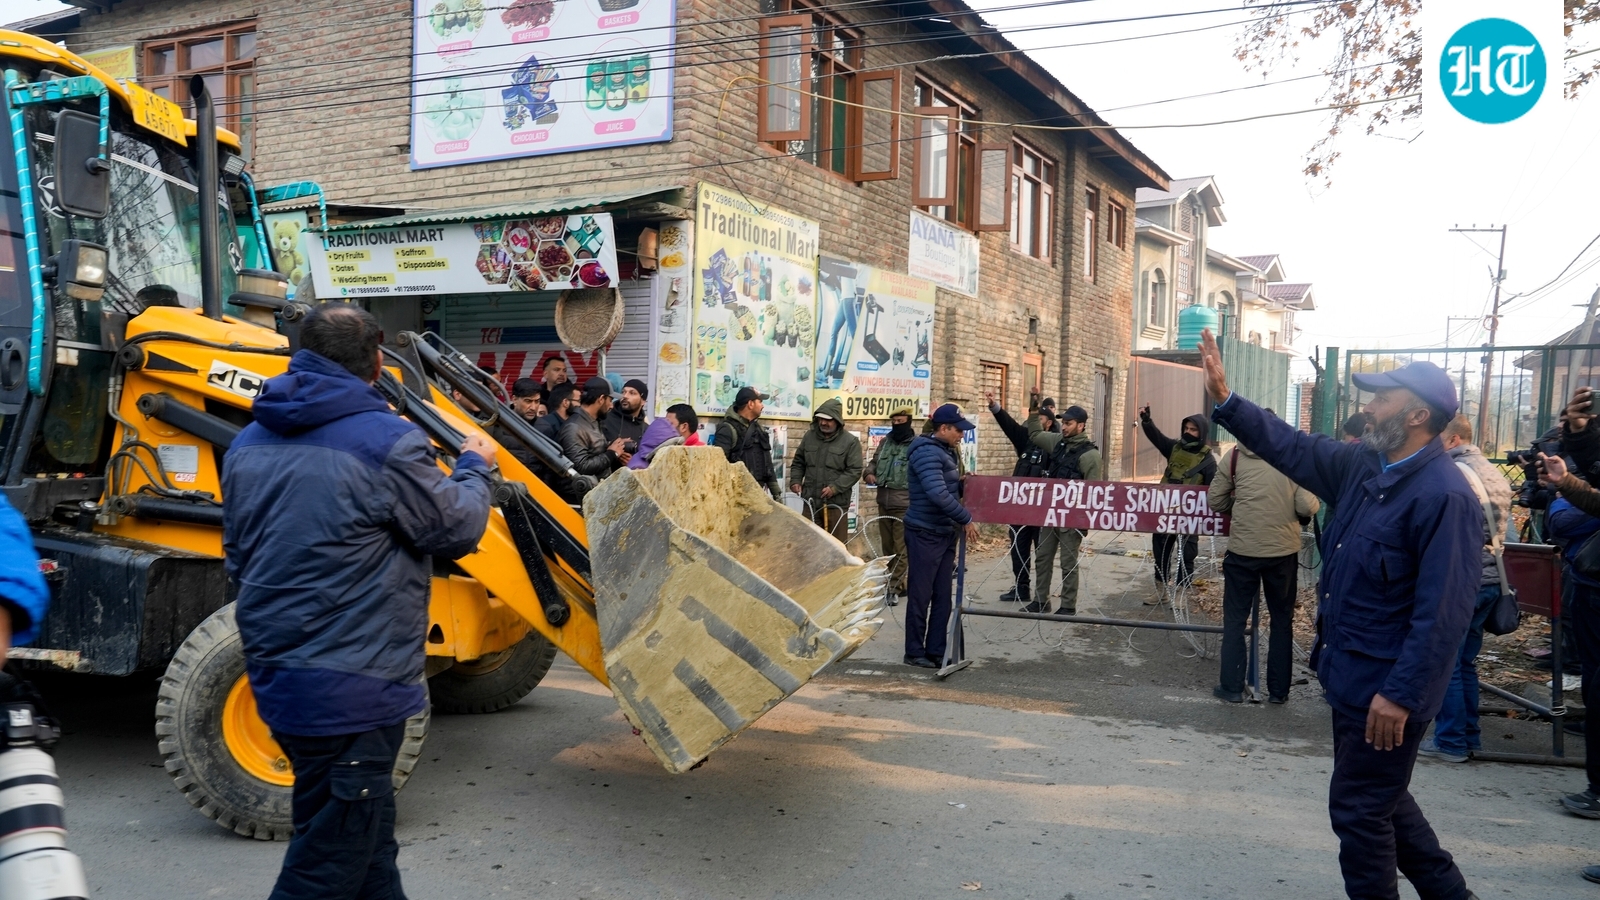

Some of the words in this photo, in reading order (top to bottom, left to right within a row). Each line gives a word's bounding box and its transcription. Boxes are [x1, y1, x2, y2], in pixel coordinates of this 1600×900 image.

[604, 14, 632, 26] BASKETS
[517, 29, 544, 41] SAFFRON
[144, 92, 170, 117] JK06
[145, 110, 178, 139] A5670
[605, 121, 624, 132] JUICE
[513, 131, 546, 143] CHOCOLATE
[435, 141, 468, 153] DISPOSABLE
[711, 191, 752, 214] 7298610003
[406, 228, 445, 243] MART
[702, 202, 781, 252] Traditional
[786, 230, 815, 261] Mart
[911, 216, 956, 251] AYANA
[333, 253, 345, 261] Dry
[346, 251, 364, 260] Fruits
[401, 248, 427, 257] Saffron
[924, 243, 956, 268] Boutique
[403, 260, 446, 271] Disposables
[337, 275, 368, 285] Wedding
[367, 275, 387, 283] Items
[880, 271, 902, 285] FITNESS
[890, 285, 918, 299] AVAILABLE
[481, 327, 501, 344] TCI
[209, 368, 262, 399] JC
[853, 375, 890, 387] INVINCIBLE
[891, 377, 926, 389] SOLUTIONS
[998, 481, 1047, 506] DISTT
[1051, 483, 1116, 511] POLICE
[1124, 486, 1221, 517] SRINAGA
[1043, 508, 1070, 528] AT
[1086, 510, 1138, 532] YOUR
[1156, 514, 1224, 536] SERVICE
